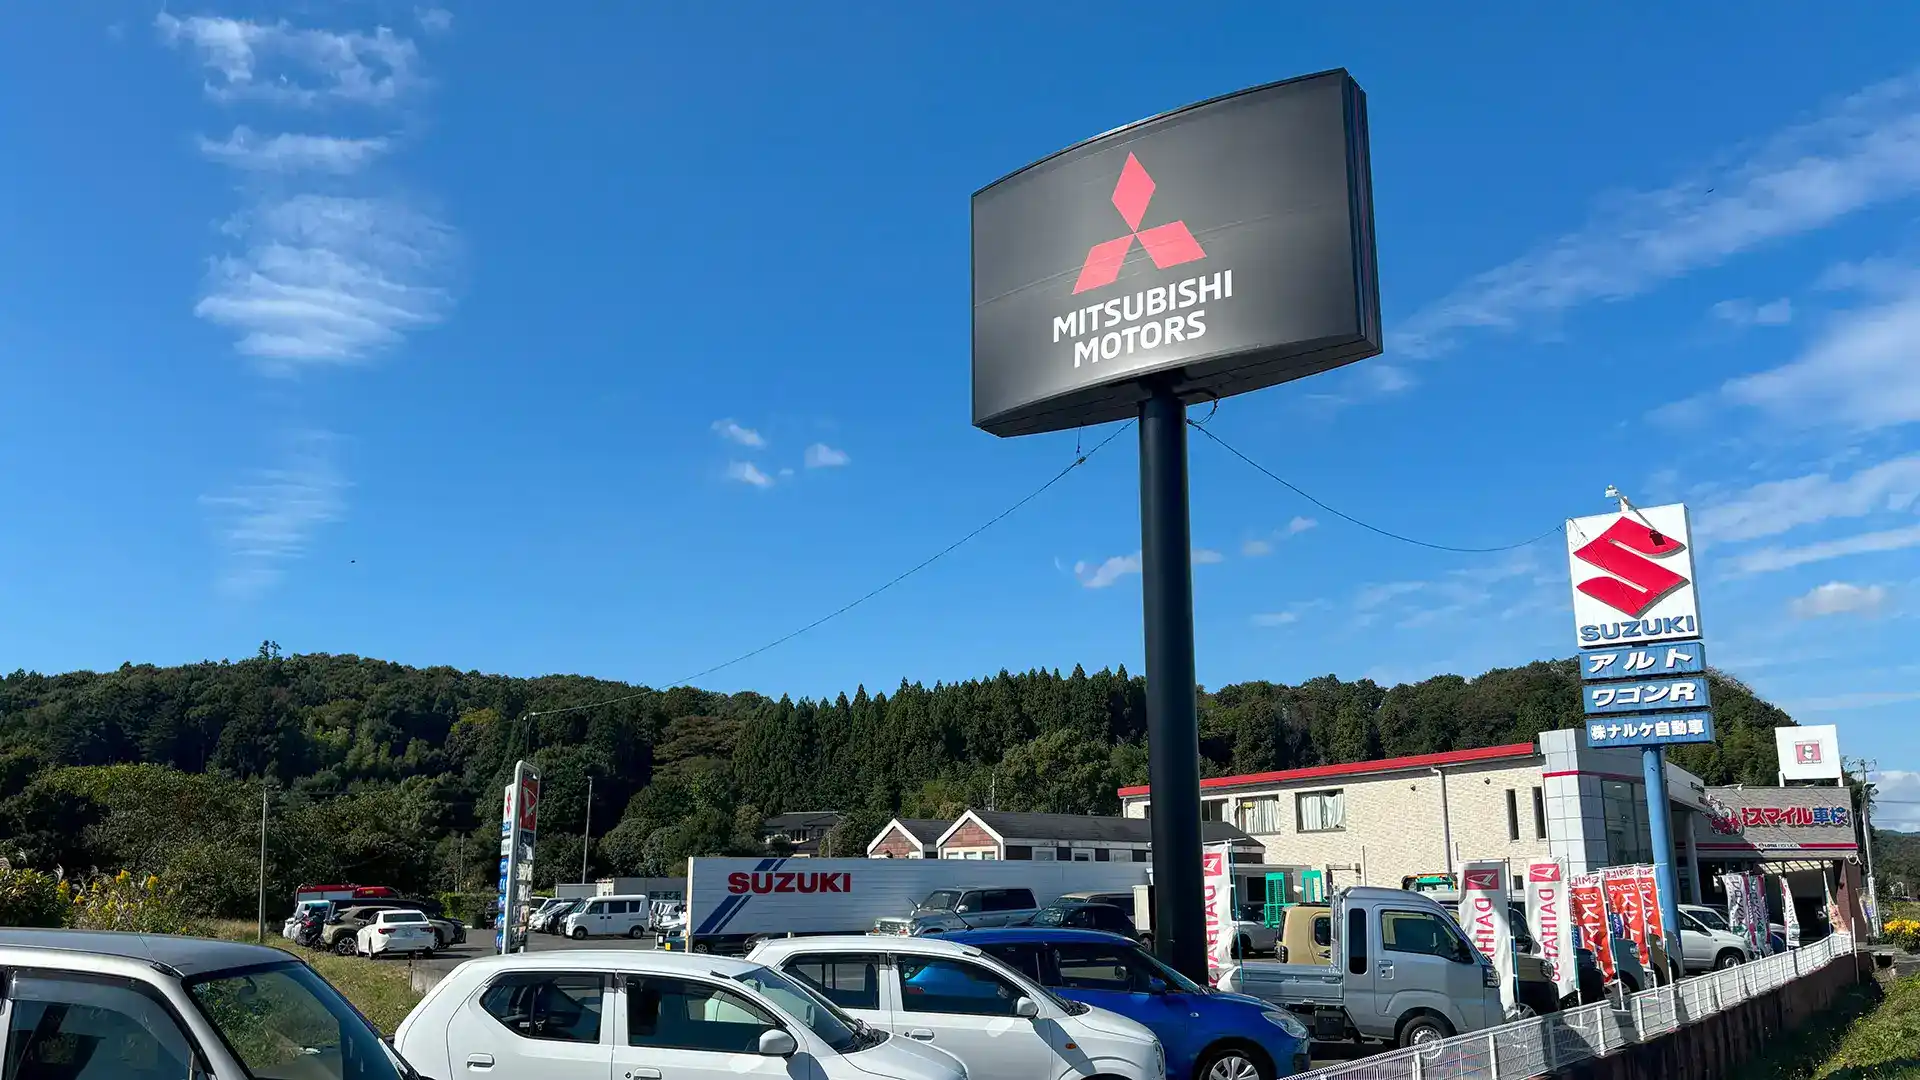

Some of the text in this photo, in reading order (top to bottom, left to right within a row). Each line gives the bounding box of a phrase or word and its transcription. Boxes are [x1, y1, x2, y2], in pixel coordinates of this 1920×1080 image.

[1053, 269, 1232, 343] MITSUBISHI
[1074, 310, 1206, 368] MOTORS
[1580, 615, 1695, 642] SUZUKI
[1588, 648, 1693, 673] アルト
[1592, 682, 1696, 707] ワゴンR
[727, 872, 852, 894] SUZUKI
